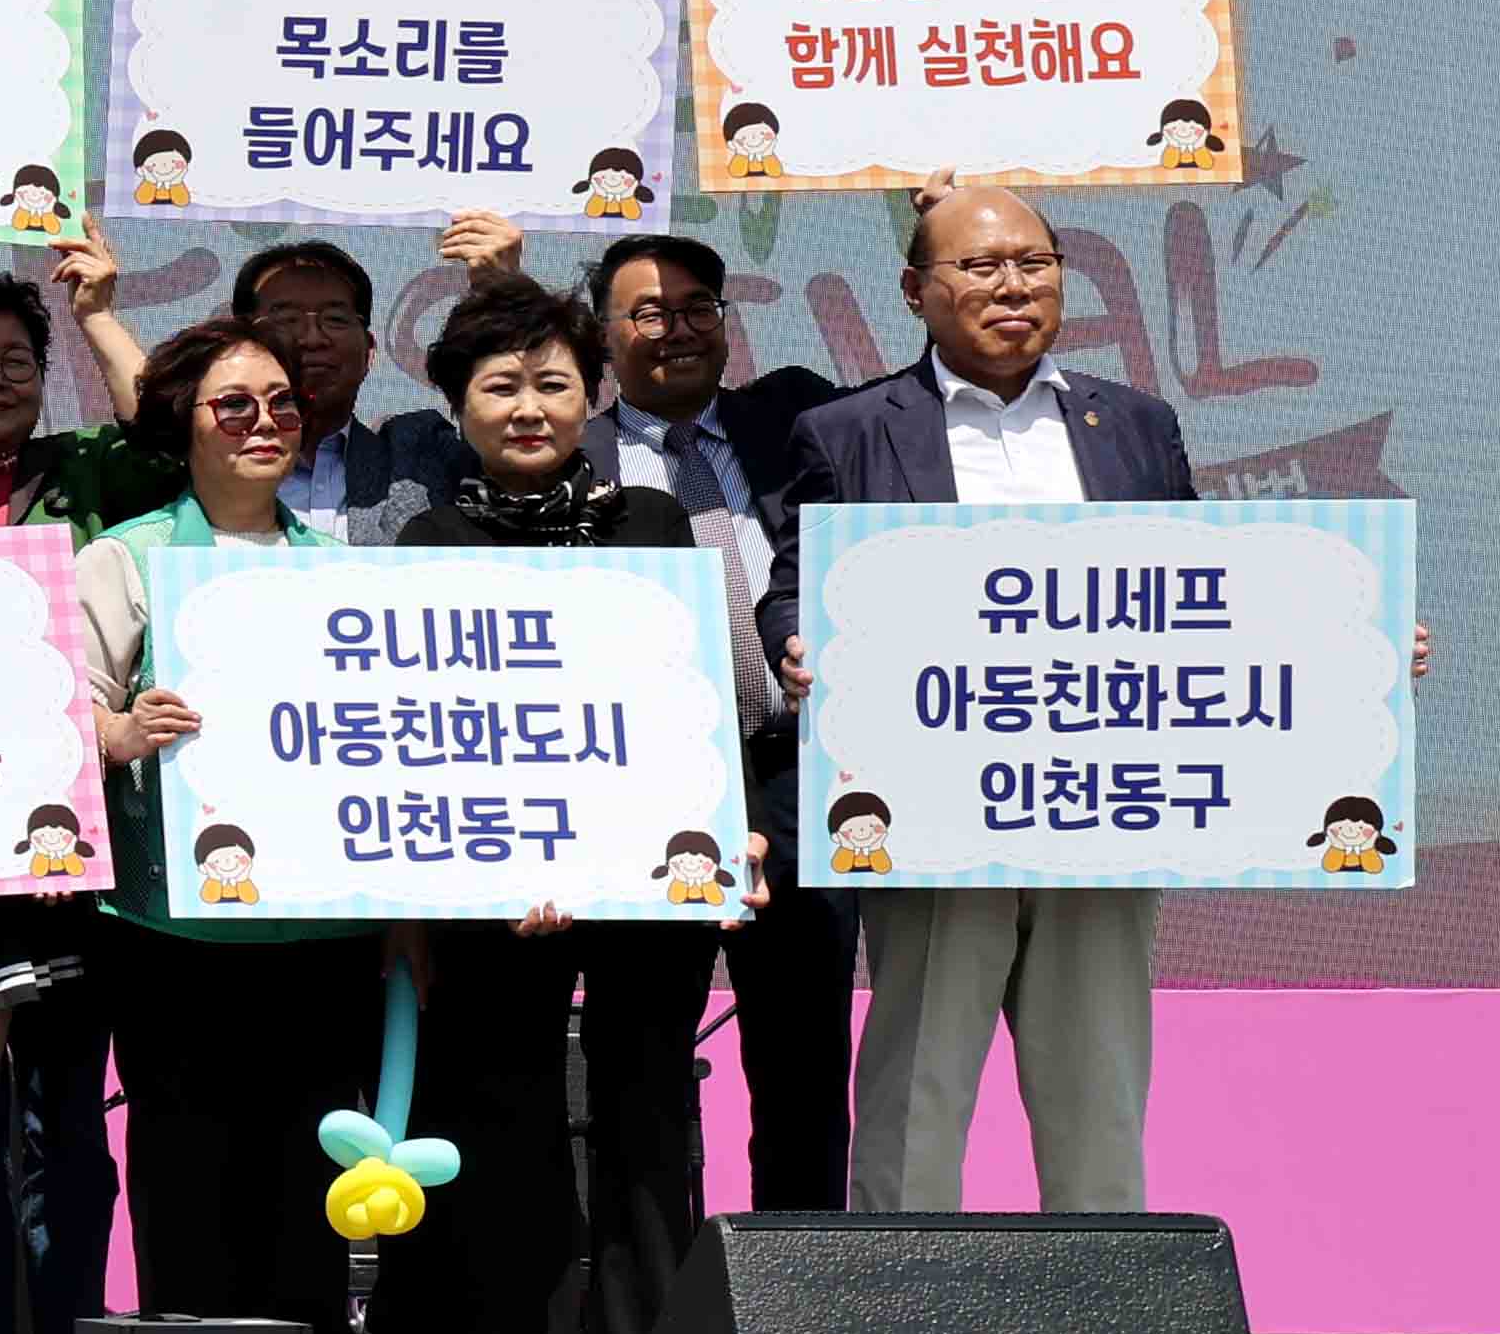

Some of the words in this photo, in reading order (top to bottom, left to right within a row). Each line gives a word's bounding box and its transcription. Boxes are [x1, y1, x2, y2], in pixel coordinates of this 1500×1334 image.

[276, 17, 508, 84] 목소리를
[785, 23, 897, 89] 함께
[918, 19, 1141, 87] 실천해요
[243, 107, 532, 173] 들어주세요
[979, 567, 1231, 634] 유니세프
[324, 608, 563, 671] 유니세프
[916, 659, 1292, 733] 아동친화도시
[270, 696, 627, 767] 아동친화도시
[338, 790, 576, 862] 인천동구
[980, 757, 1230, 830] 인천동구
